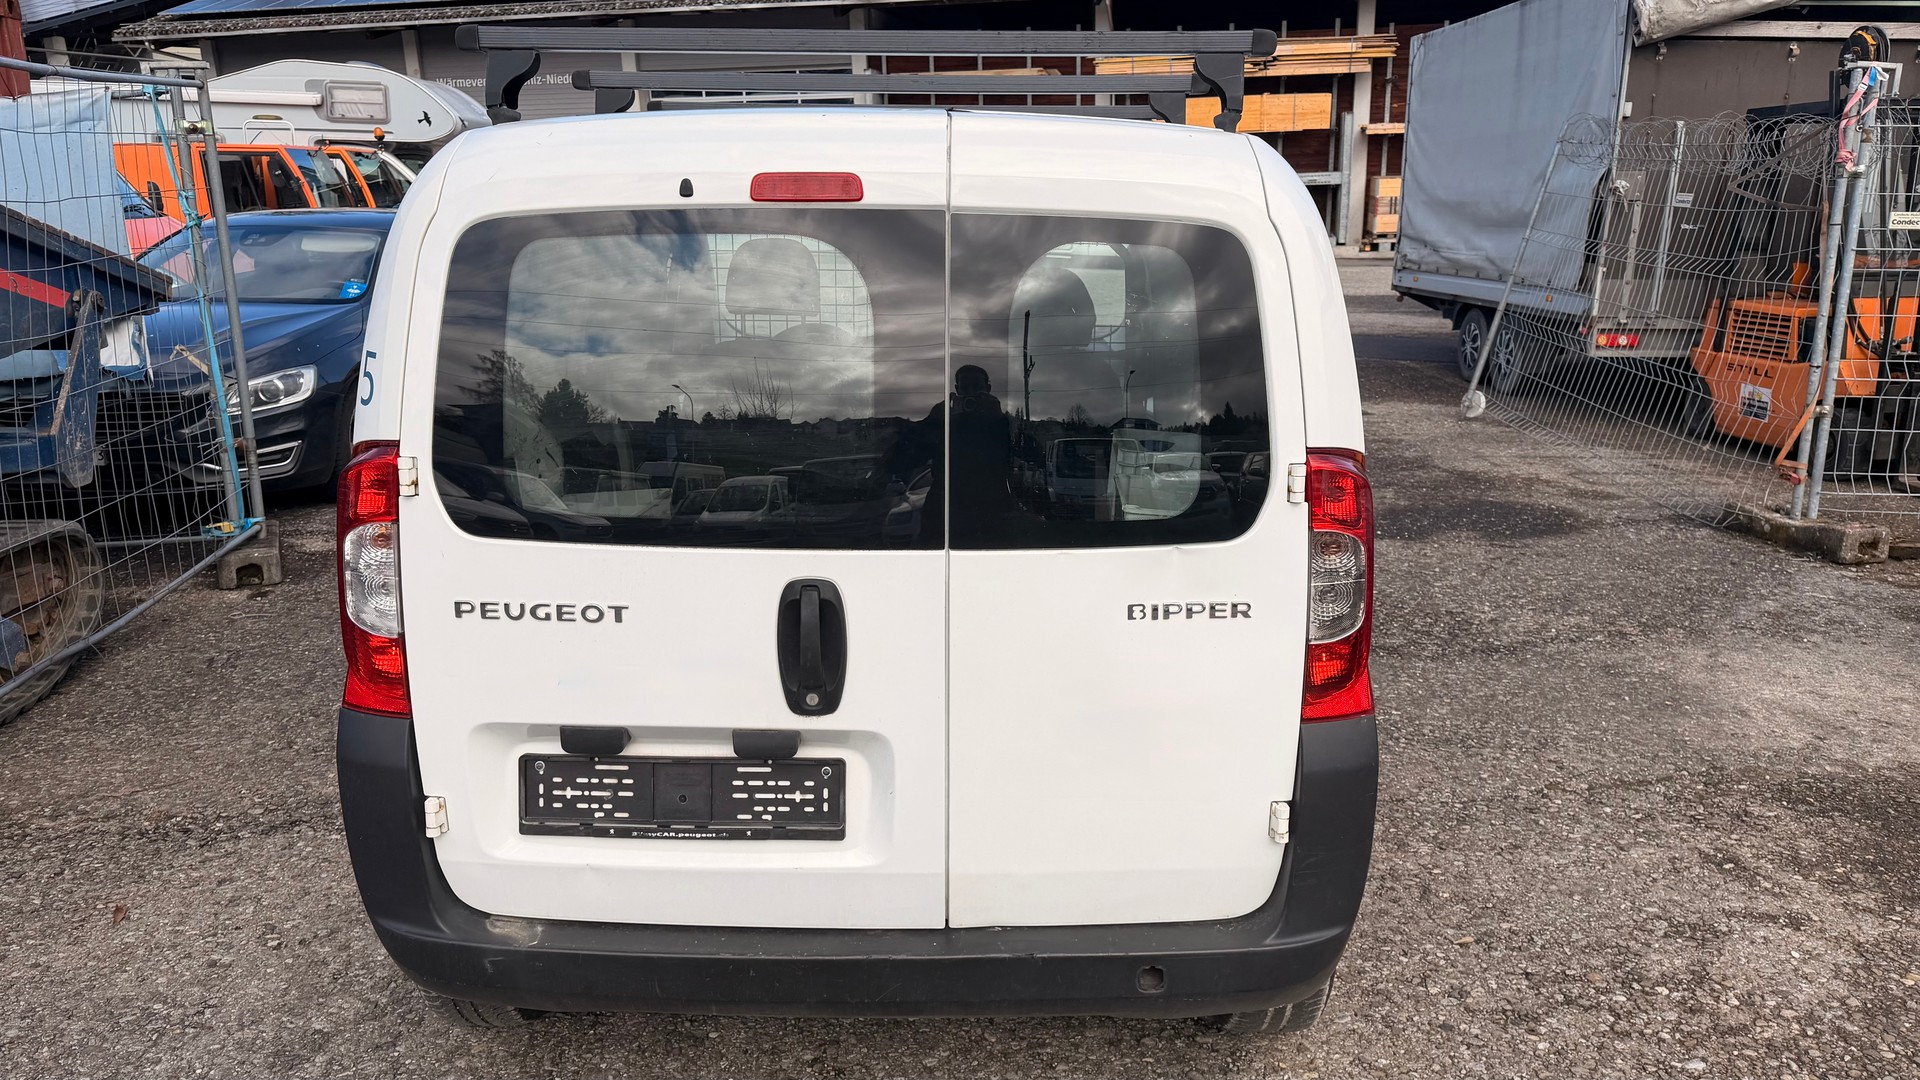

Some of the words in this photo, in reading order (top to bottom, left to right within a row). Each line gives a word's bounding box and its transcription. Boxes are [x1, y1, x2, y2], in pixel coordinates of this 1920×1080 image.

[360, 350, 377, 406] 5
[1727, 362, 1774, 379] STILL
[453, 599, 629, 623] PEUGEOT
[1127, 602, 1252, 621] BIPPER
